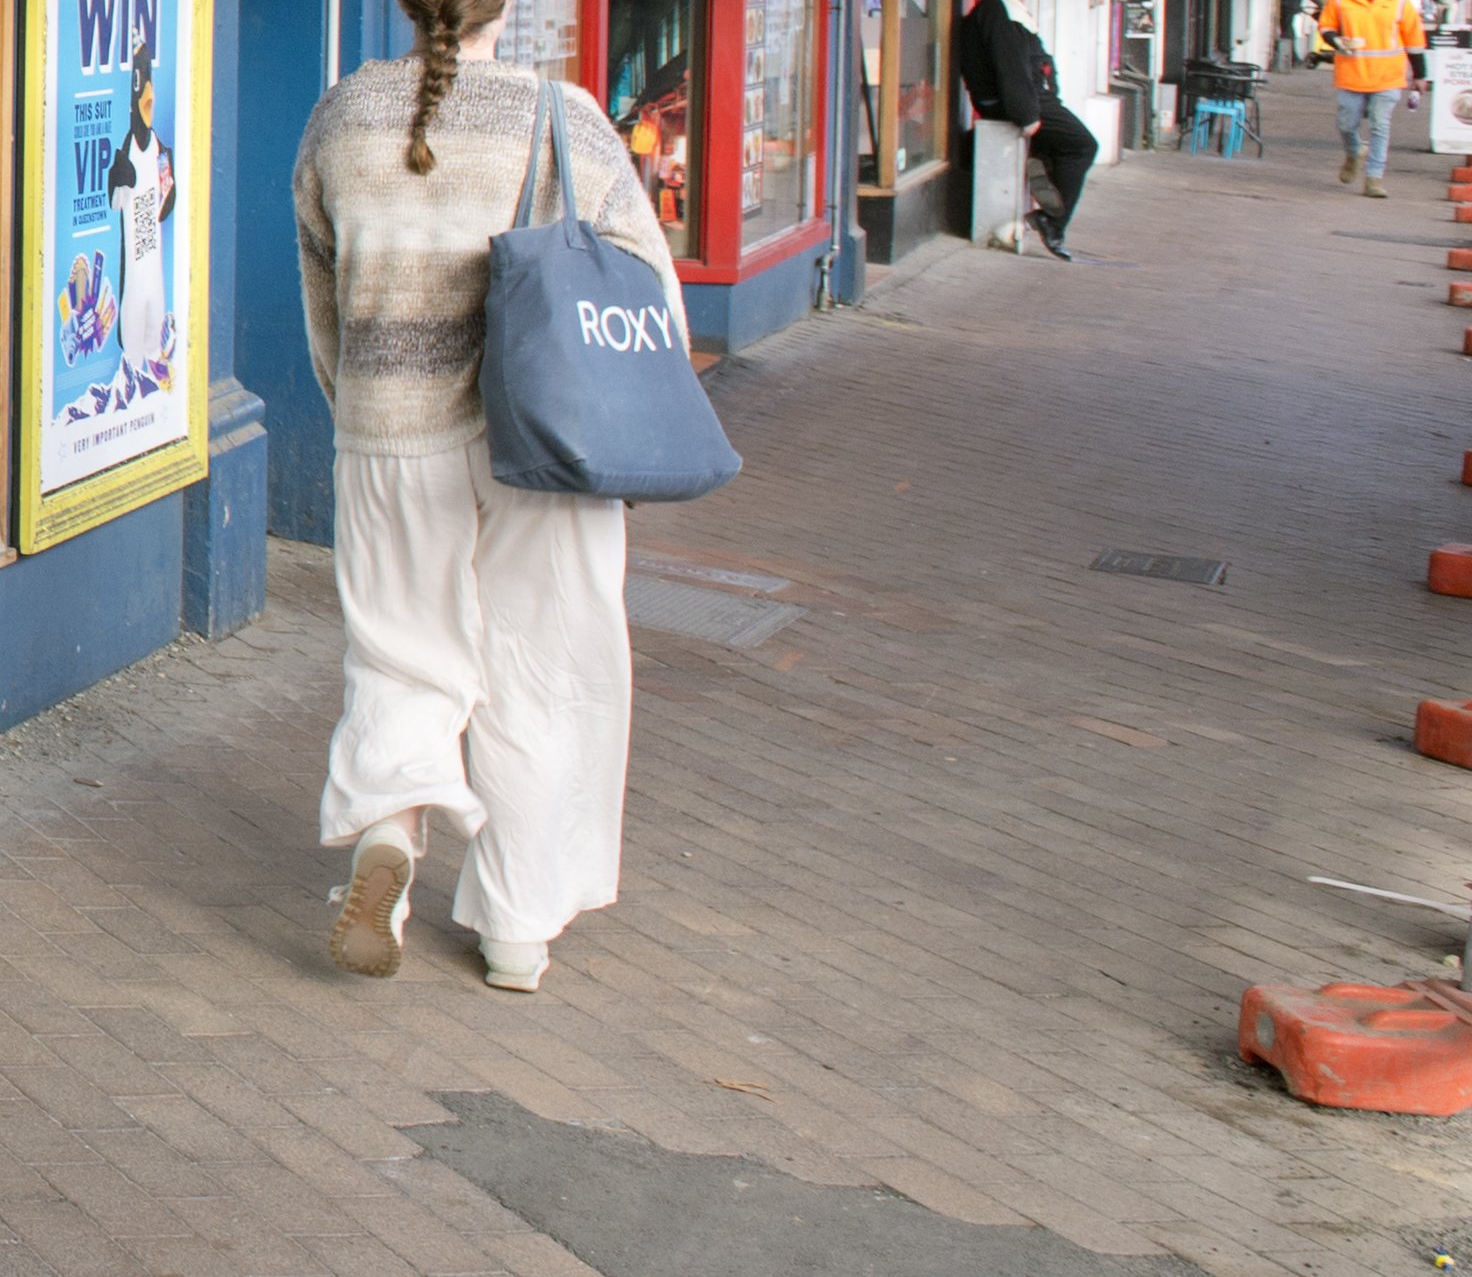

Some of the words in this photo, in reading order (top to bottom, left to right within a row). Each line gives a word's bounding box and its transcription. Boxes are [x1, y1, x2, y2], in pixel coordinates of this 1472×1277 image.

[74, 103, 93, 123] THIS
[94, 100, 112, 120] SUIT
[74, 137, 112, 195] VIP
[73, 193, 106, 212] TREATMENT
[576, 300, 673, 353] ROXY
[73, 437, 90, 454] VERY
[92, 423, 128, 447] IMPORTANT
[129, 412, 155, 433] PENGUIN
